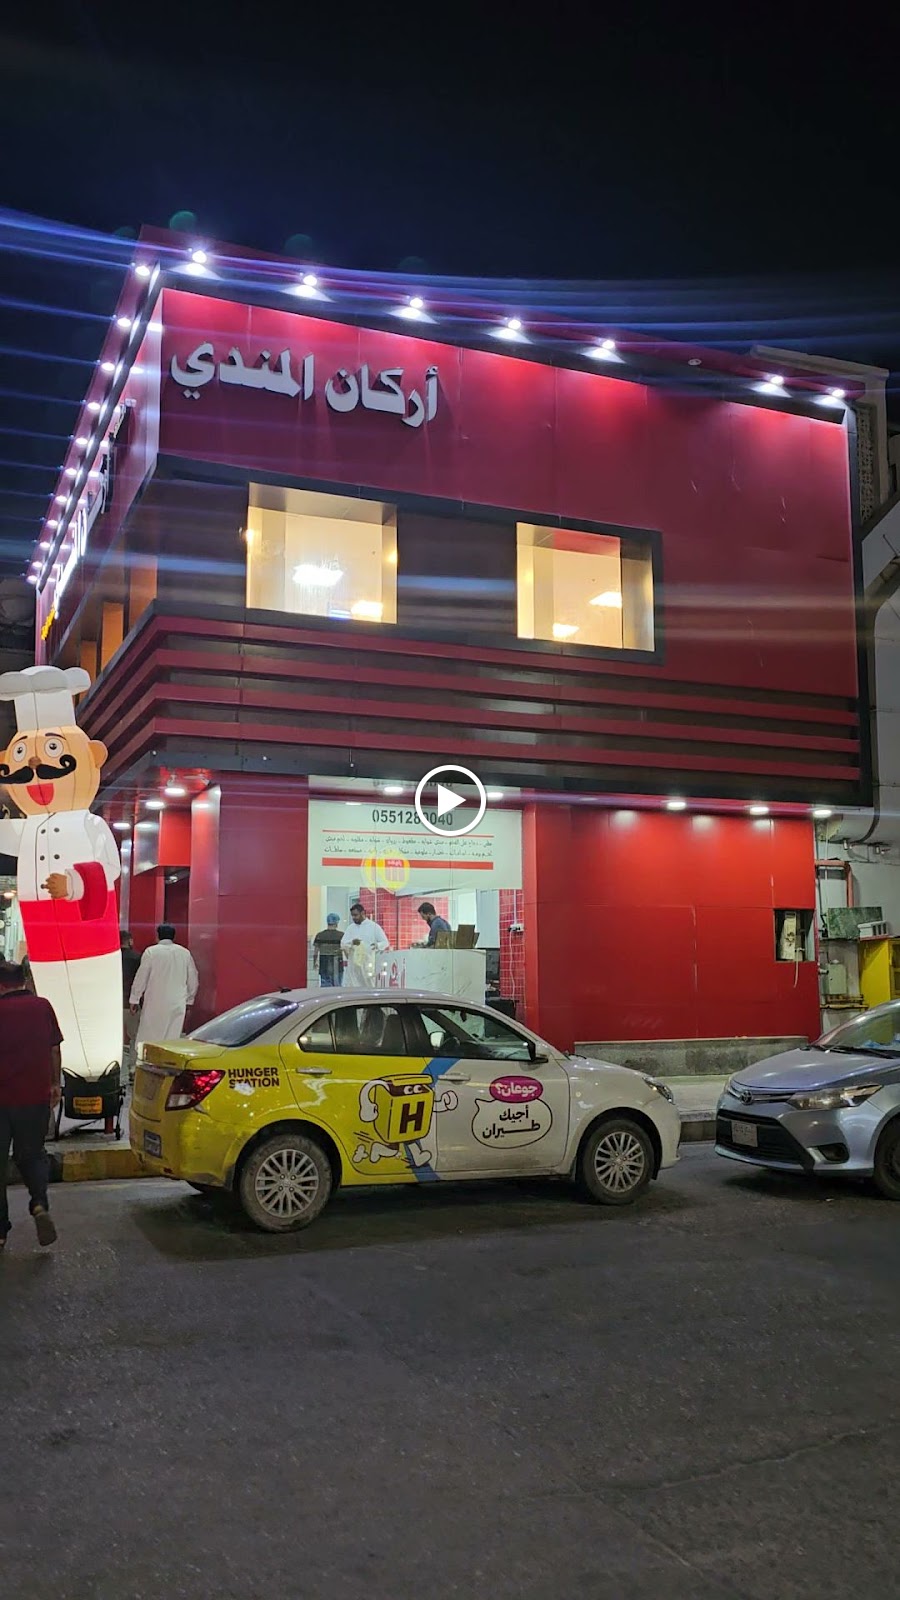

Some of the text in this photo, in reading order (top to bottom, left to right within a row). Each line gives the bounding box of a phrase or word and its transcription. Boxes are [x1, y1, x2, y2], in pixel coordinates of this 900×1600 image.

[171, 341, 438, 427] أركان المندي
[228, 1067, 278, 1078] HUNGER
[495, 1082, 538, 1097] جوعان؟
[400, 1101, 425, 1134] H
[499, 1105, 529, 1123] أجيك
